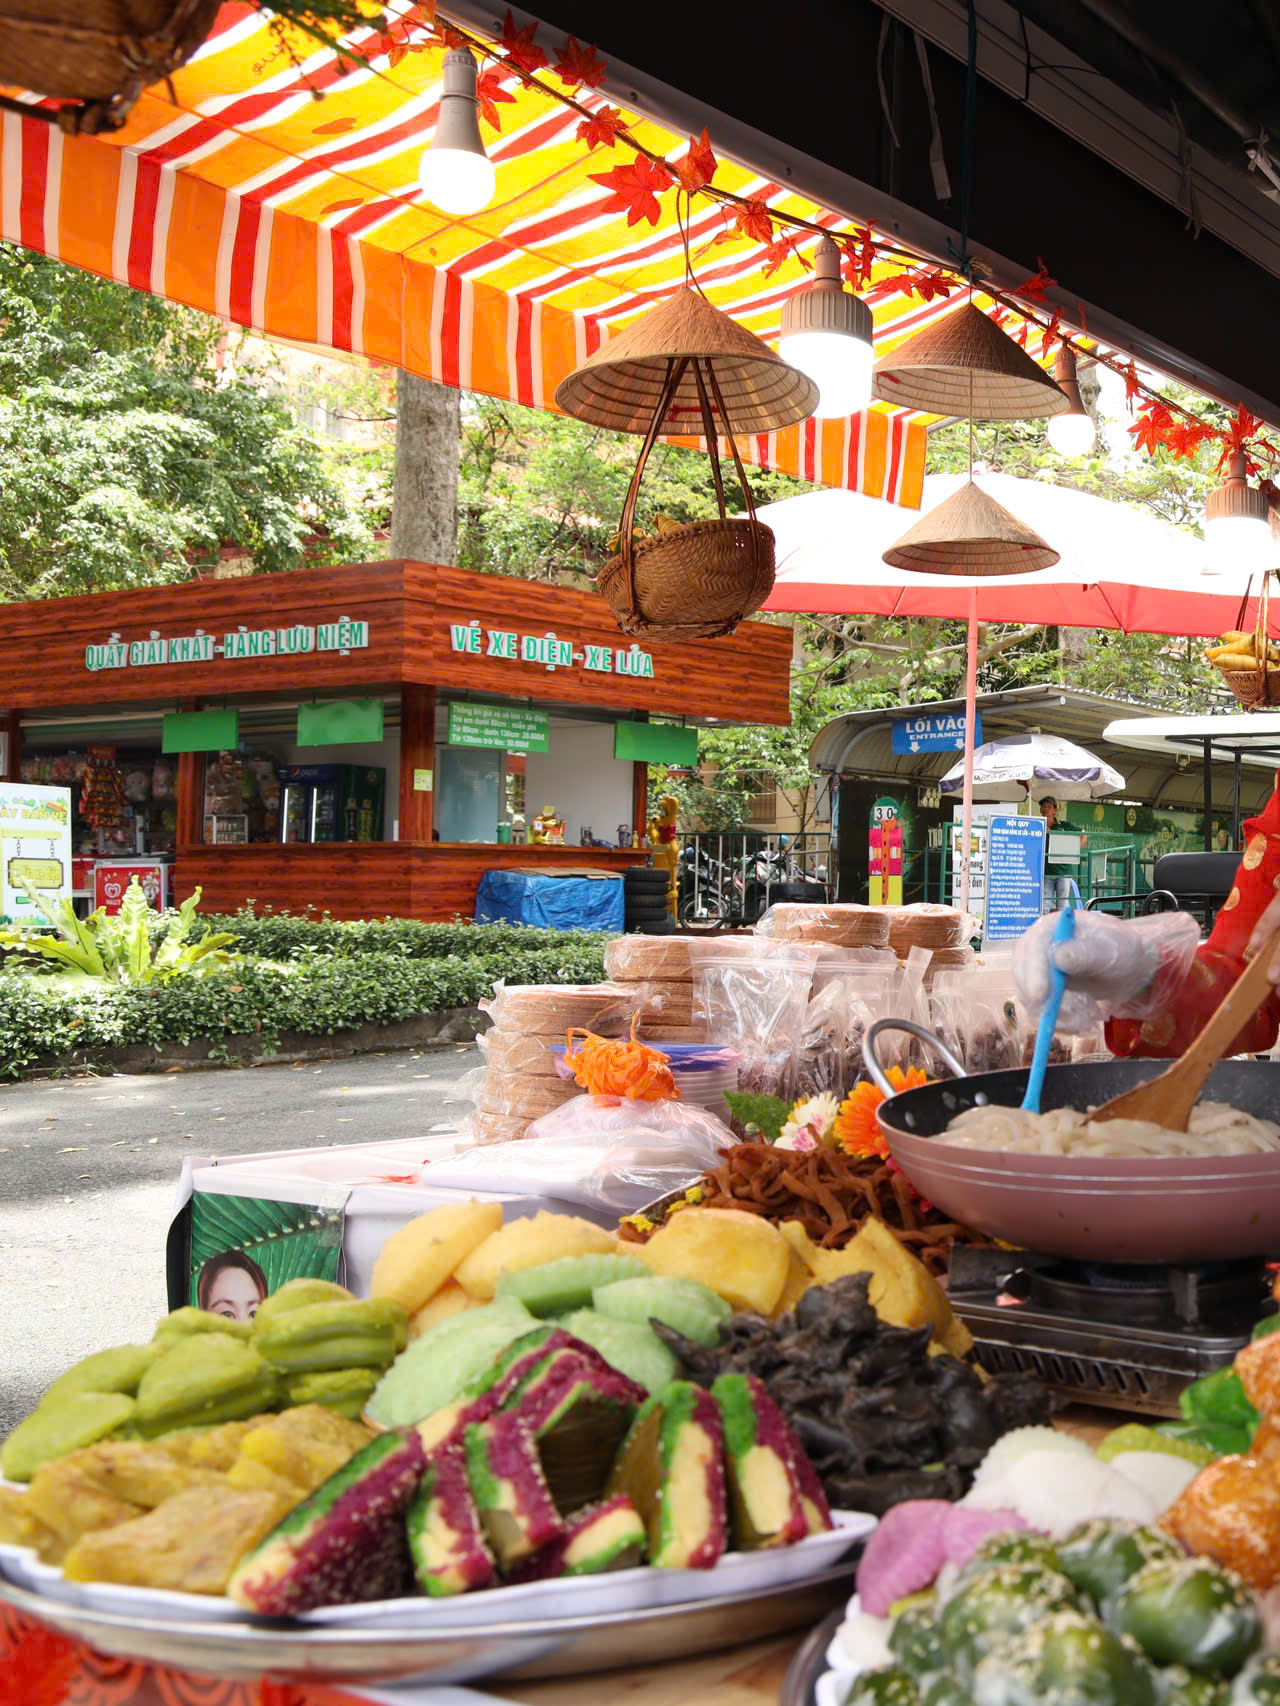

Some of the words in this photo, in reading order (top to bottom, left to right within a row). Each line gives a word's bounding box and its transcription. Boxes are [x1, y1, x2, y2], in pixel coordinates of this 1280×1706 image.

[86, 632, 128, 671] QUẦY
[130, 630, 168, 666] GIẢI
[277, 625, 315, 654] LƯU
[317, 616, 369, 656] NIỆM
[450, 620, 481, 654] VÉ
[487, 631, 518, 659] XE
[615, 644, 654, 677] LỬA
[906, 716, 931, 733] LỐI
[936, 716, 966, 731] VÀO
[909, 731, 964, 740] ENTRANCE
[1006, 819, 1017, 828] NỘI
[1018, 820, 1030, 828] QUY
